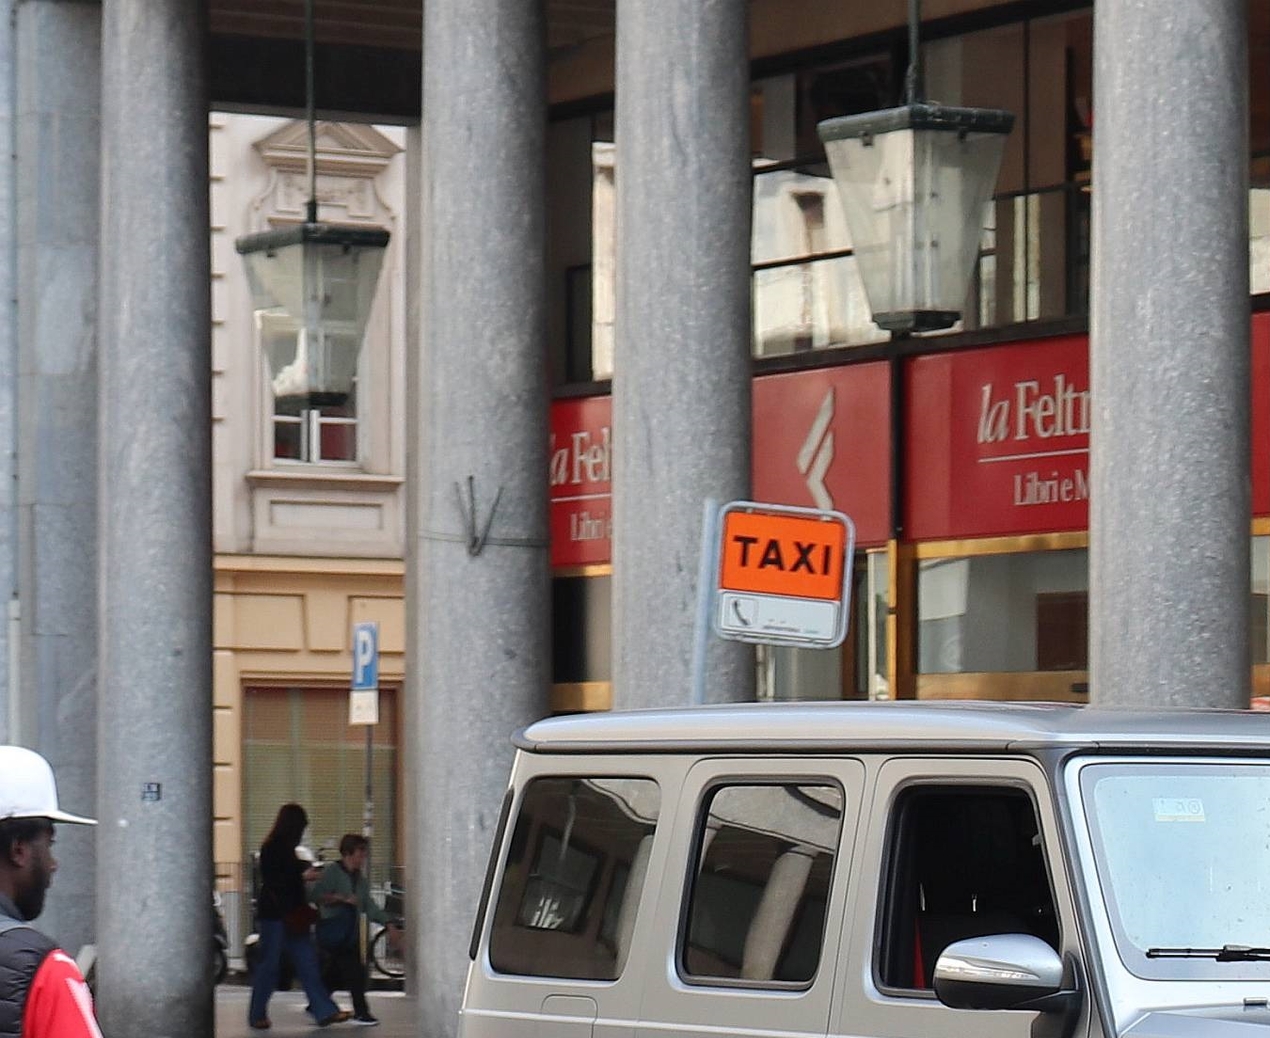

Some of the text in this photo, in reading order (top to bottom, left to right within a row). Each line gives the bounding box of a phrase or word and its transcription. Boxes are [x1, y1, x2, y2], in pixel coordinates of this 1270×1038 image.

[977, 383, 1009, 444] la
[1014, 471, 1059, 505] Libri
[1060, 478, 1073, 501] e
[733, 535, 832, 575] TAXI
[355, 630, 374, 684] P
